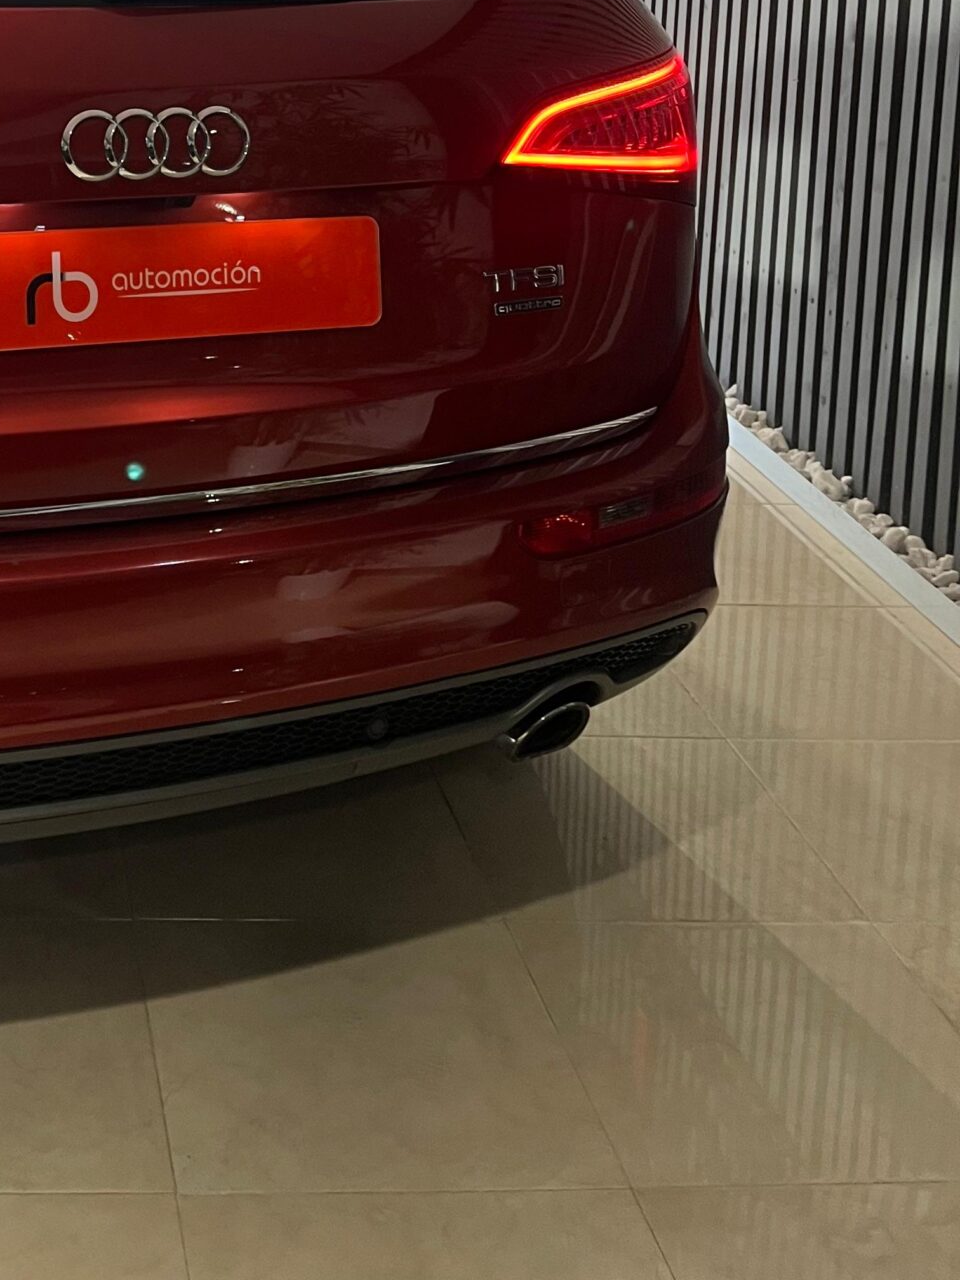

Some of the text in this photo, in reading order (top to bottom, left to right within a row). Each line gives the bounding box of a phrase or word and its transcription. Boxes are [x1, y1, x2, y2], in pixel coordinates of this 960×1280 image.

[26, 251, 262, 326] rb automoción
[482, 264, 565, 293] TFSI
[498, 299, 561, 314] quattro
